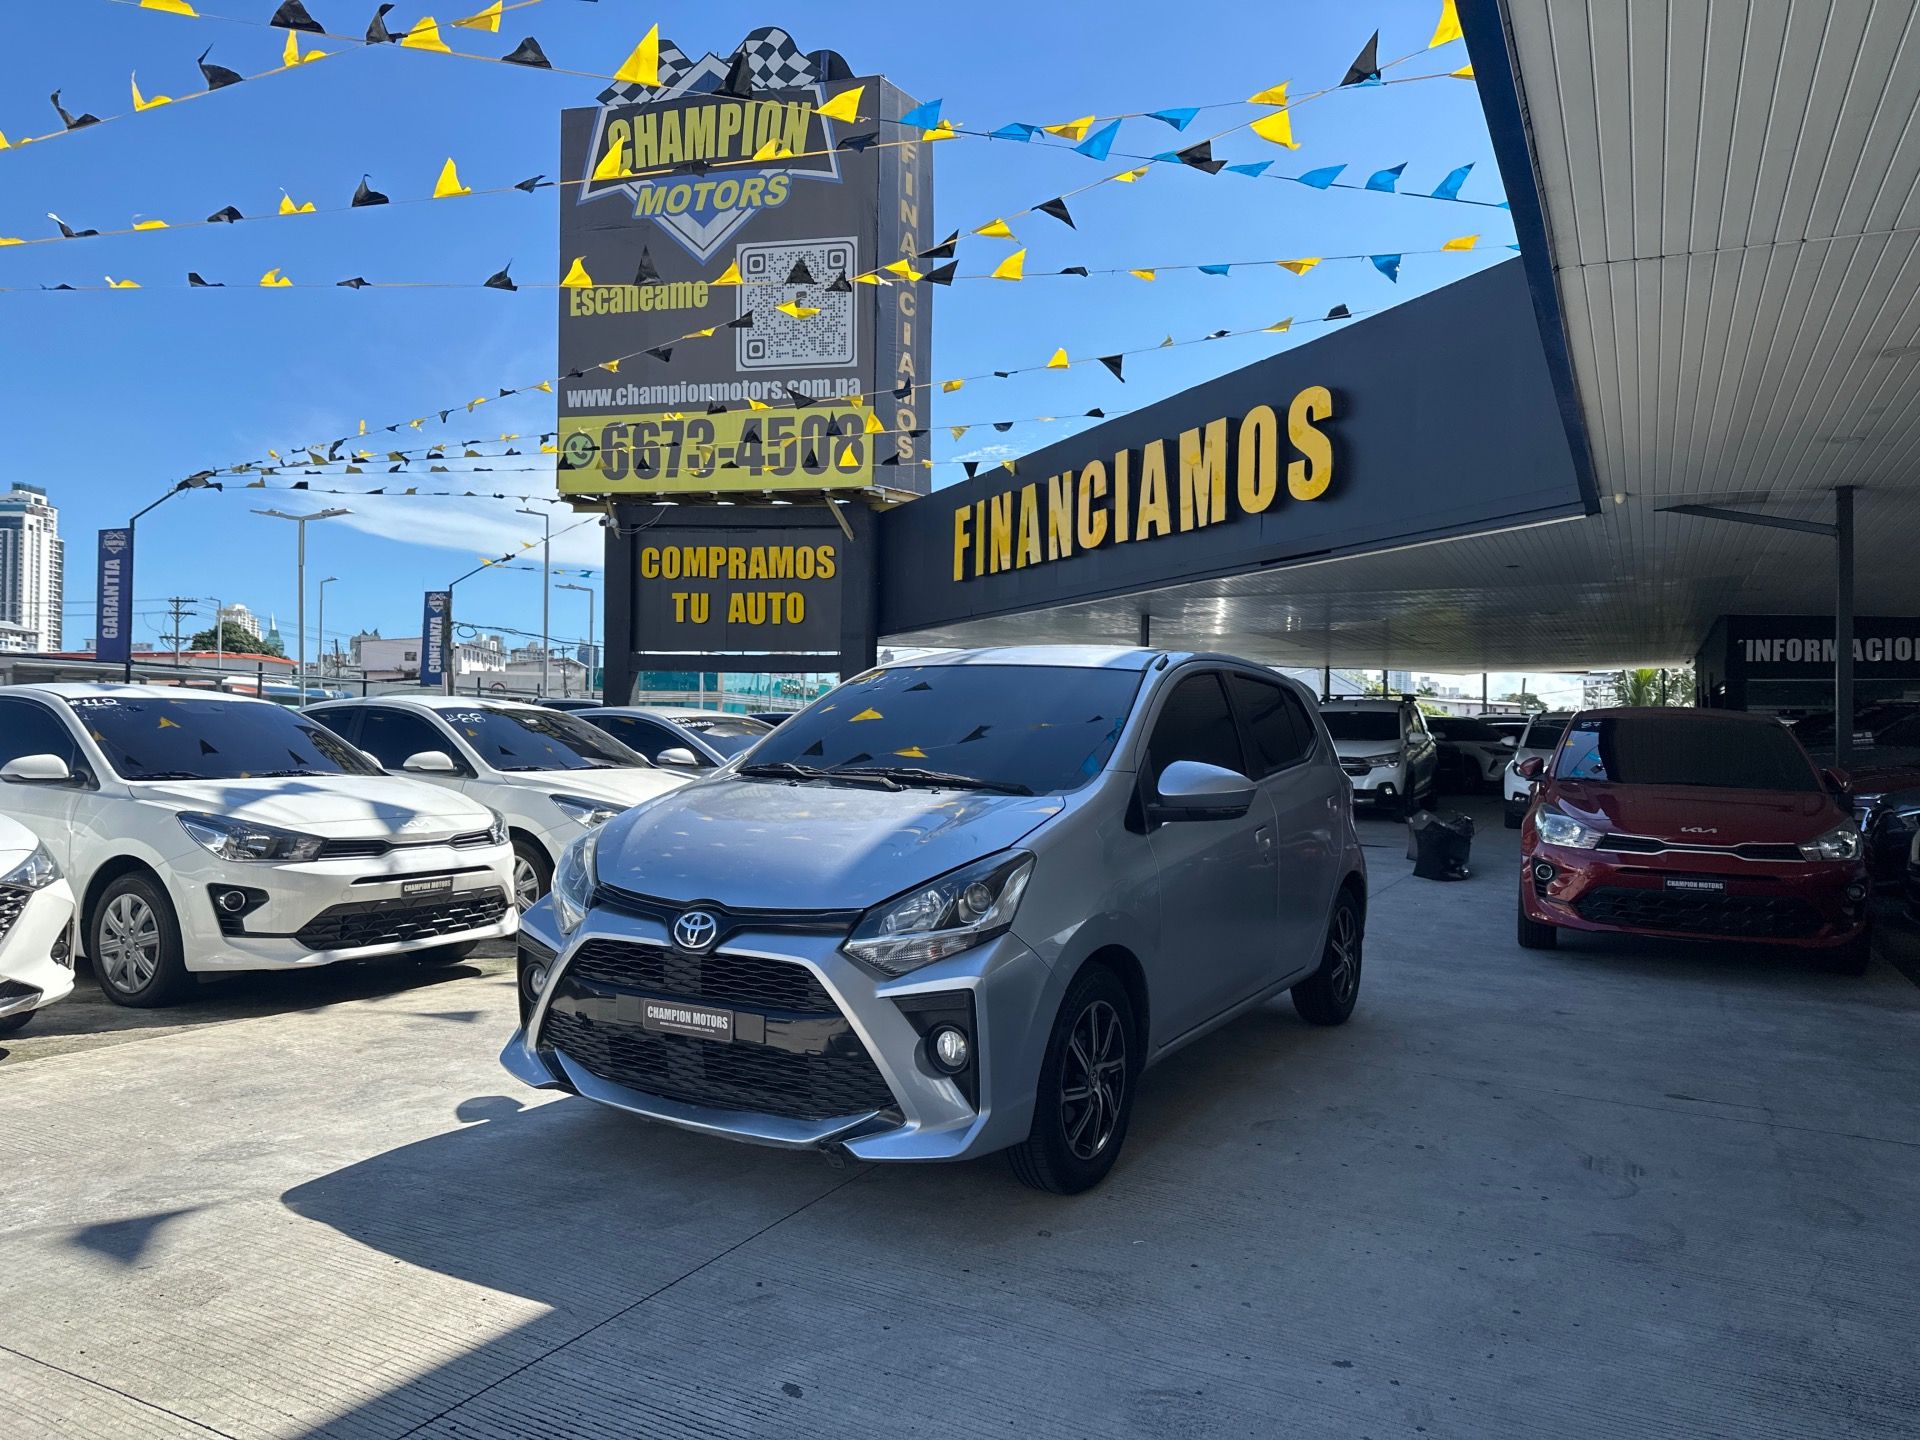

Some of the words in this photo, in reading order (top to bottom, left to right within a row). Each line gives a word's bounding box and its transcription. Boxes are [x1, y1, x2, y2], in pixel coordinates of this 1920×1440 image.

[608, 101, 811, 170] CHAMPION
[635, 176, 790, 215] MOTORS
[570, 280, 708, 316] Escaneame
[567, 378, 860, 408] www.championmotors.com.pa
[601, 414, 865, 481] 6673-4508
[953, 386, 1332, 581] FINANCIAMOS
[641, 546, 836, 579] COMPRAMOS
[102, 559, 120, 639] GARANTIA
[672, 592, 709, 624] TU
[728, 592, 806, 625] AUTO
[428, 616, 442, 673] CONFIANZA
[1667, 880, 1697, 888] CHAMPION
[1698, 882, 1724, 890] MOTORS
[647, 1005, 691, 1024] CHAMPION
[692, 1012, 728, 1030] MOTORS
